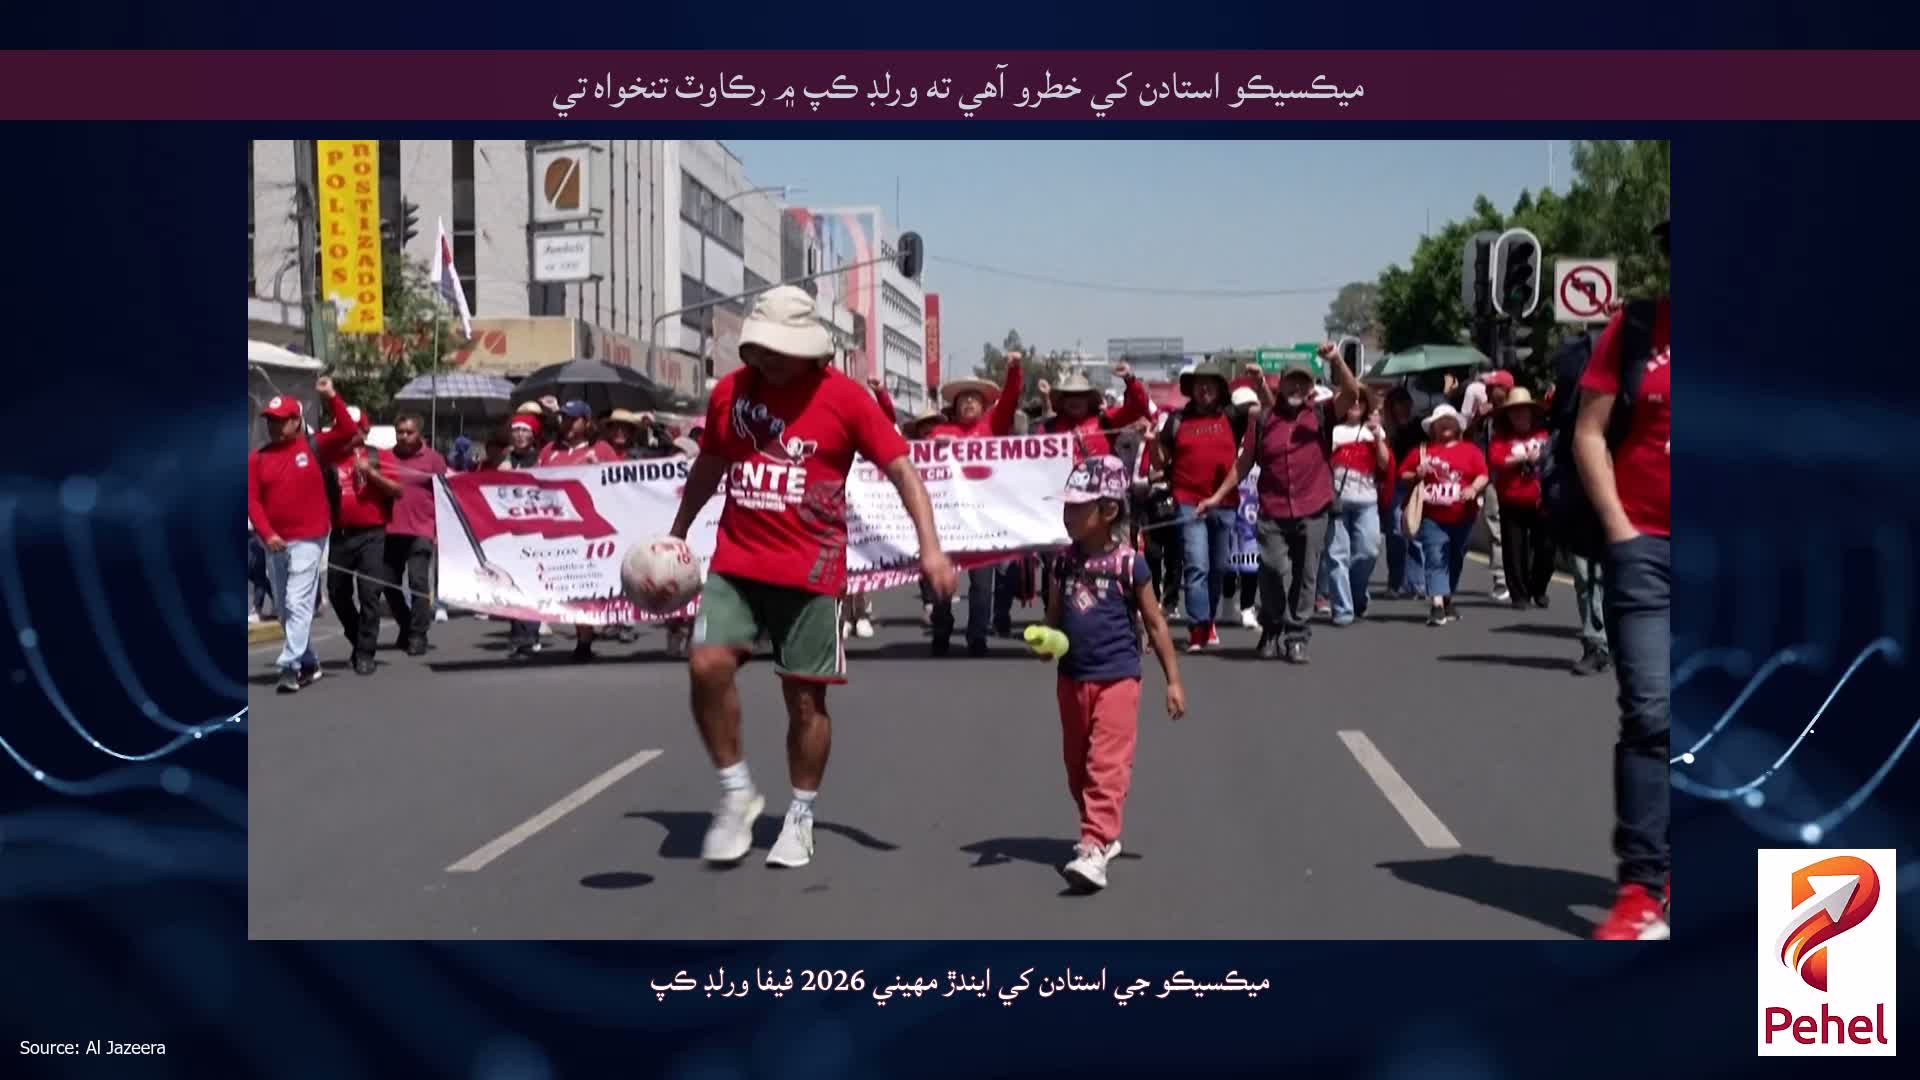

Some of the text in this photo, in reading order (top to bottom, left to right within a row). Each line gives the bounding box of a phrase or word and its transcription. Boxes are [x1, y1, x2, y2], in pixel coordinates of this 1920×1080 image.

[326, 149, 349, 285] POLLOS
[351, 143, 376, 323] ROSTIZADOS
[908, 437, 1068, 464] NCEREMOS!
[601, 461, 688, 486] ¡UNIDOS
[730, 461, 807, 496] CNTE
[586, 541, 615, 560] 10
